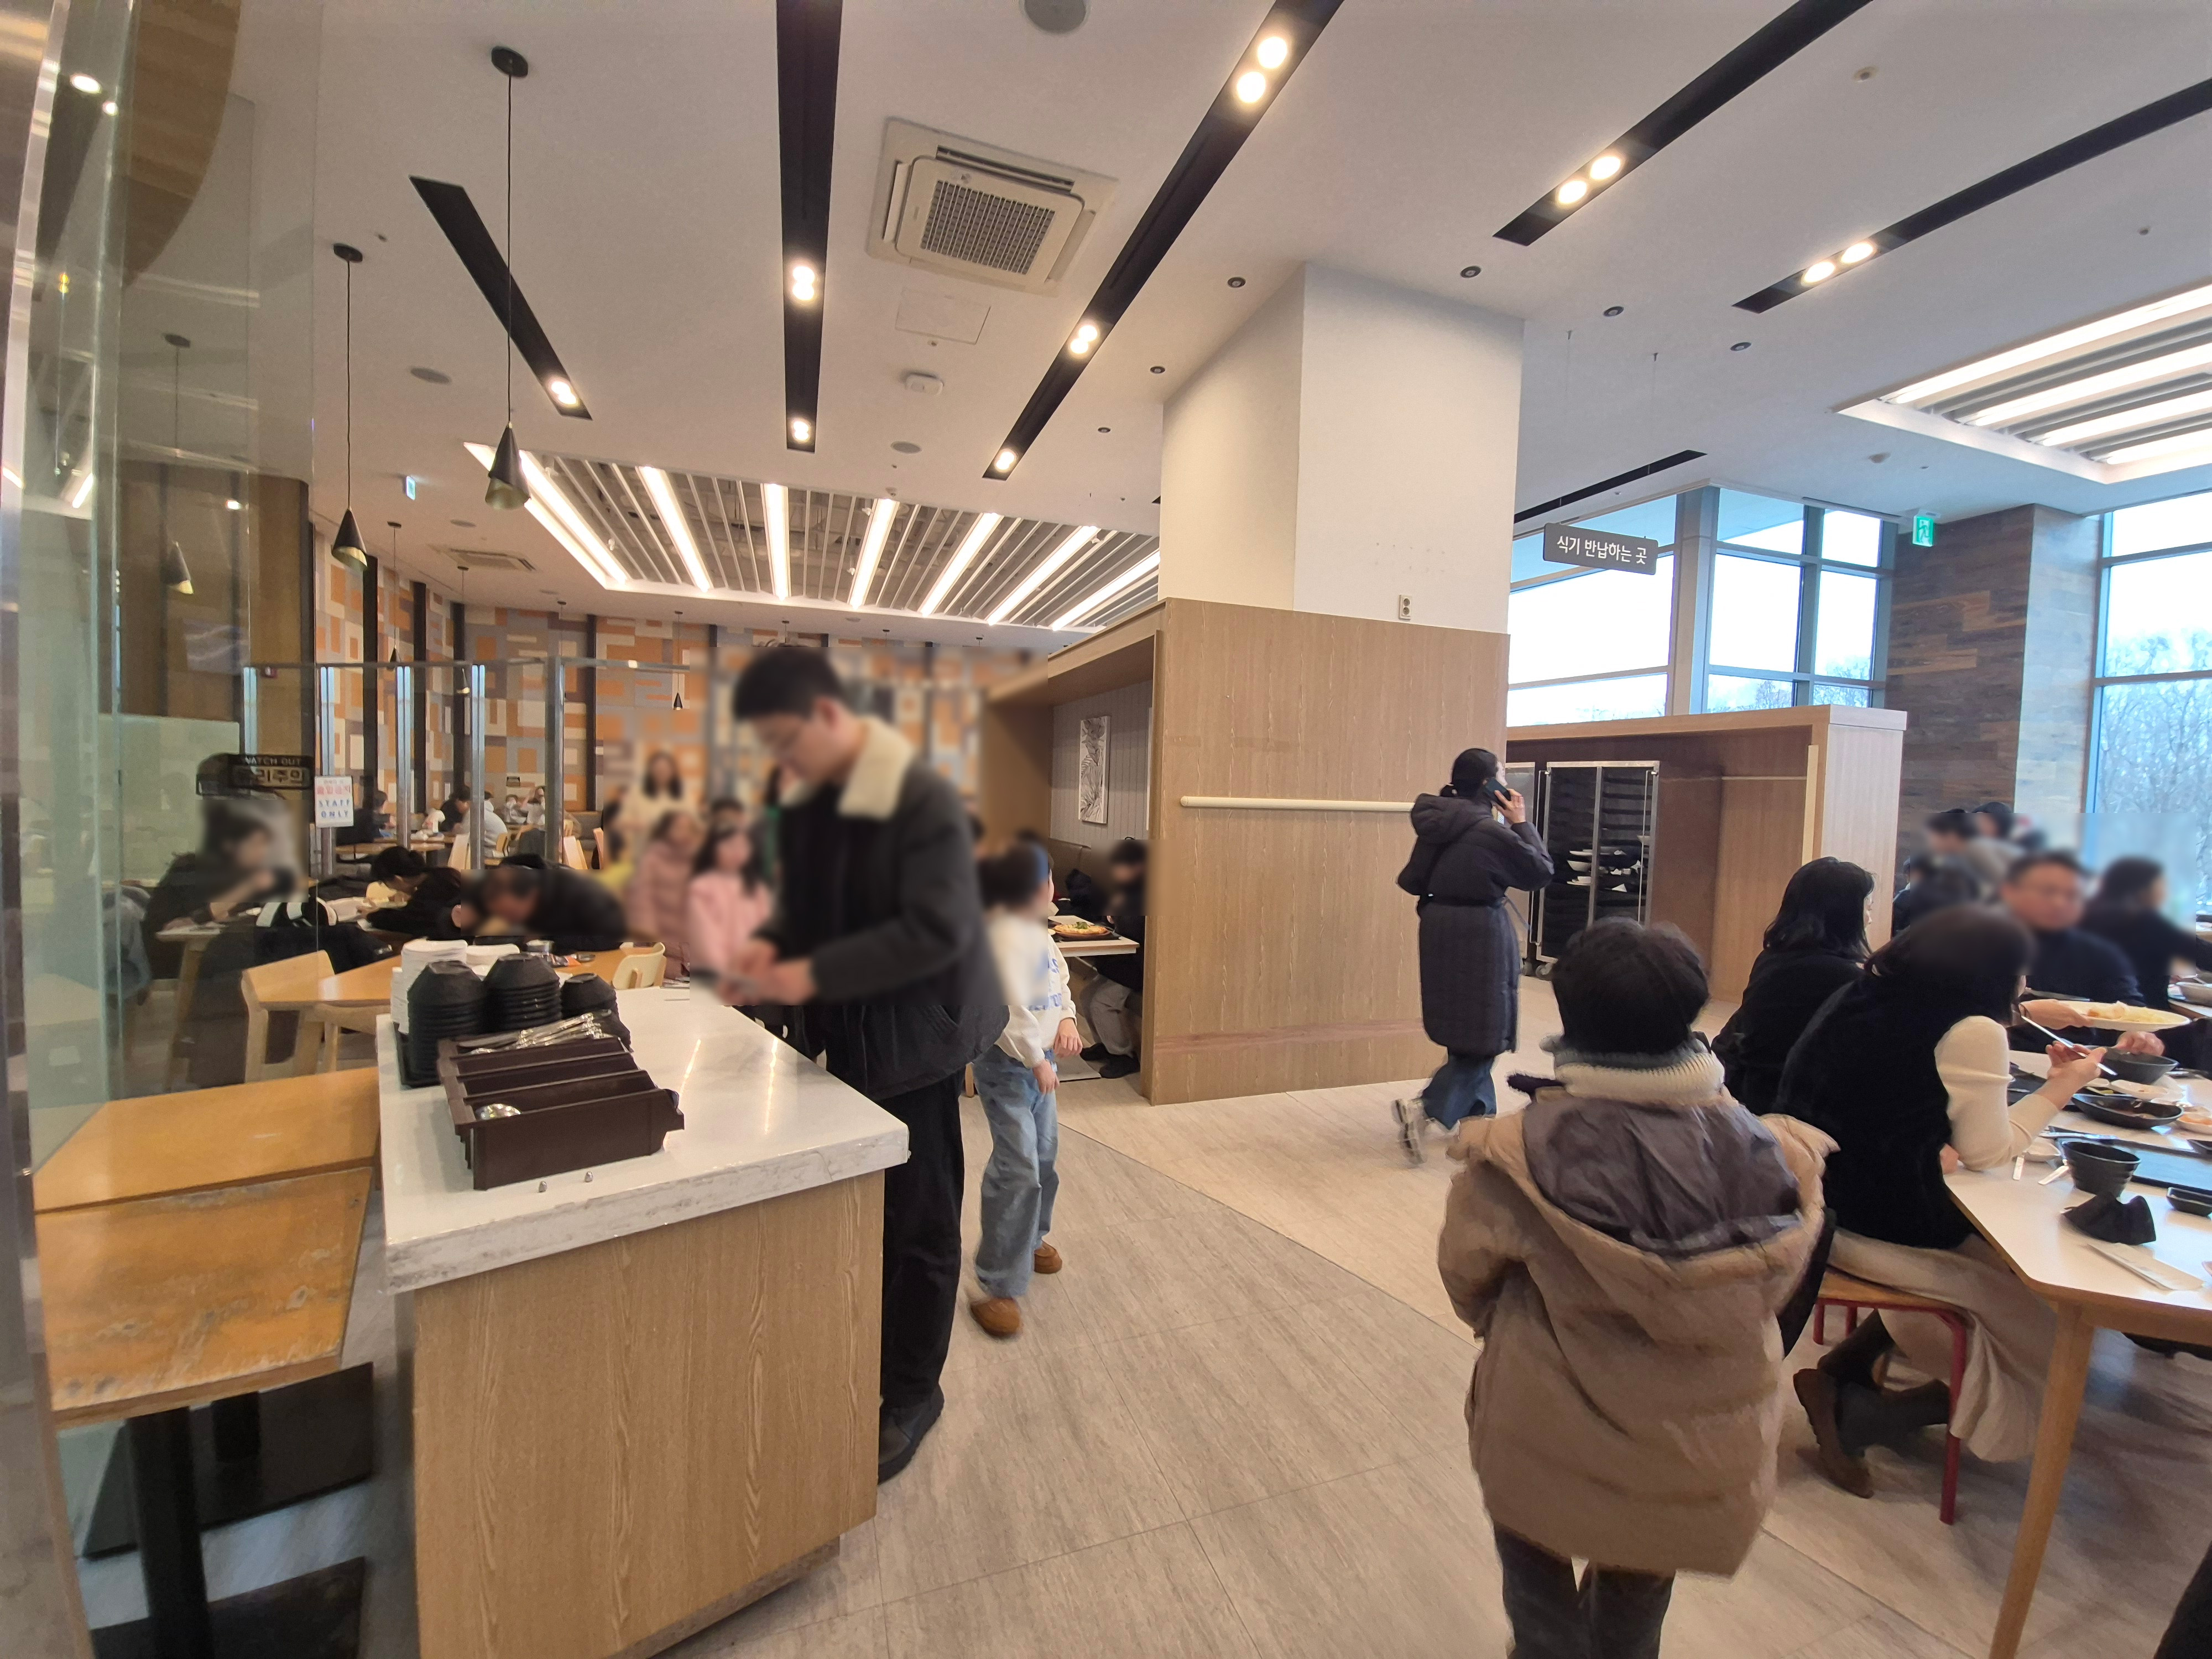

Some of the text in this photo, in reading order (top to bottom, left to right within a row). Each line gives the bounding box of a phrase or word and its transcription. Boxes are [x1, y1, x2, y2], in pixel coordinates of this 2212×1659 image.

[1557, 535, 1647, 565] 식기 반납하는 곳
[281, 758, 301, 766] OUT
[319, 799, 350, 807] STAFF
[321, 810, 348, 819] ONLY
